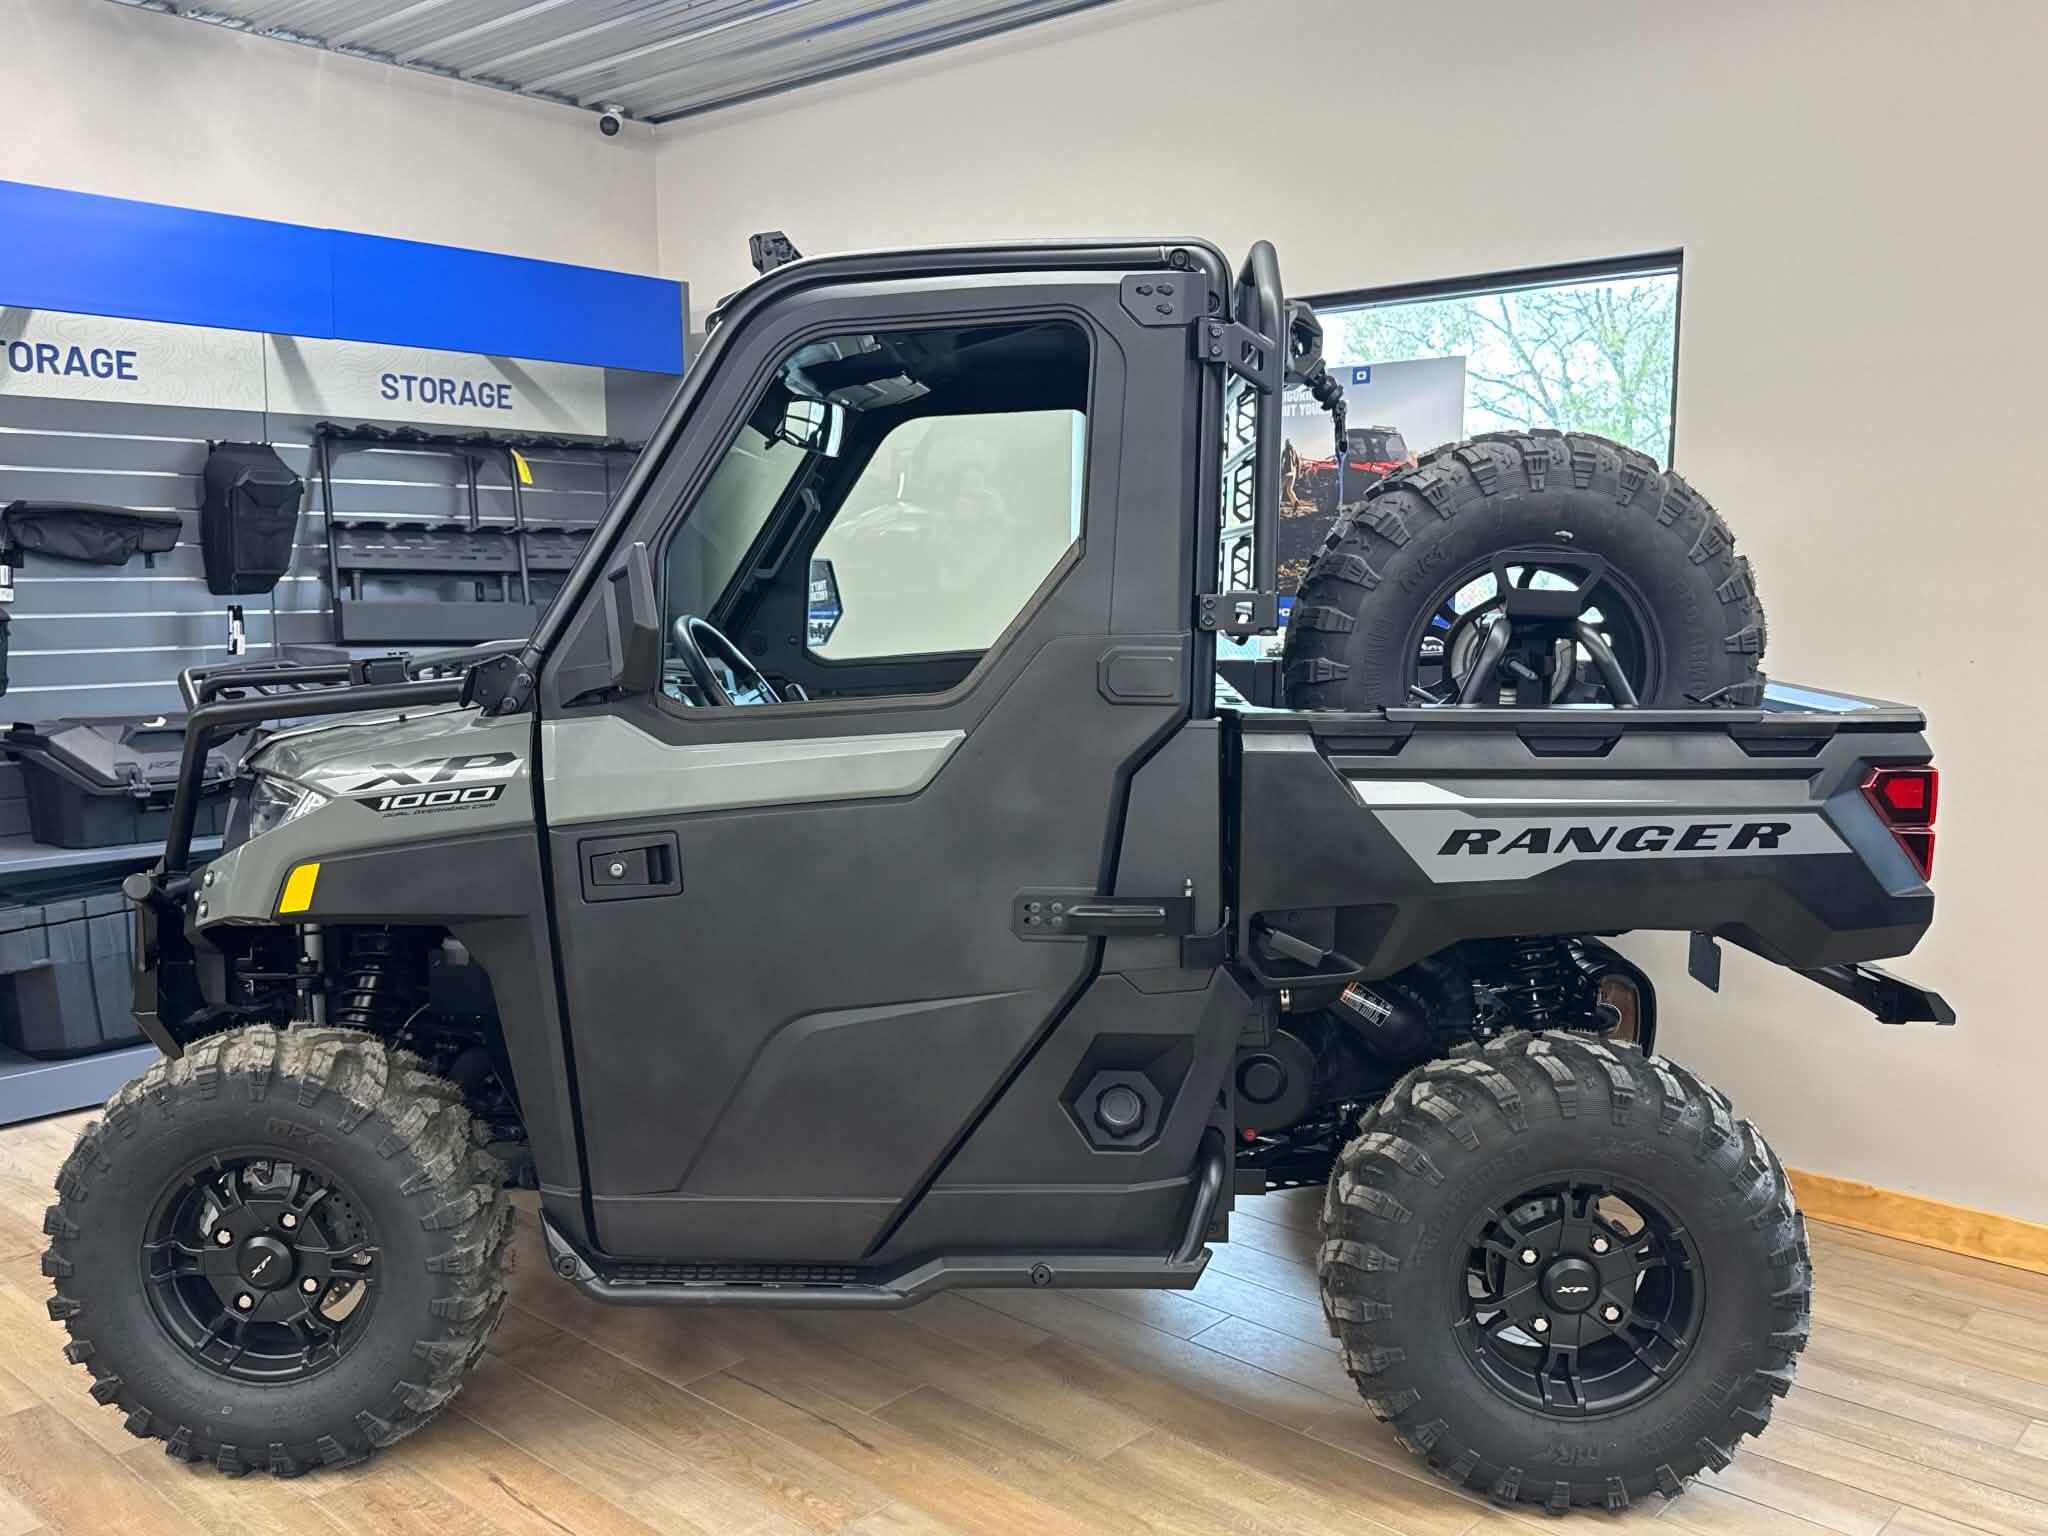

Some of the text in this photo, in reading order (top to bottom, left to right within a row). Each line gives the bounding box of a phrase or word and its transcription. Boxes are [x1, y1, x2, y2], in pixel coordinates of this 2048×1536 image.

[0, 339, 138, 381] ORAGE
[380, 373, 513, 410] STORAGE
[346, 752, 518, 792] XP
[377, 786, 497, 811] 1000
[1436, 822, 1792, 856] RANGER
[1556, 1286, 1589, 1294] XP
